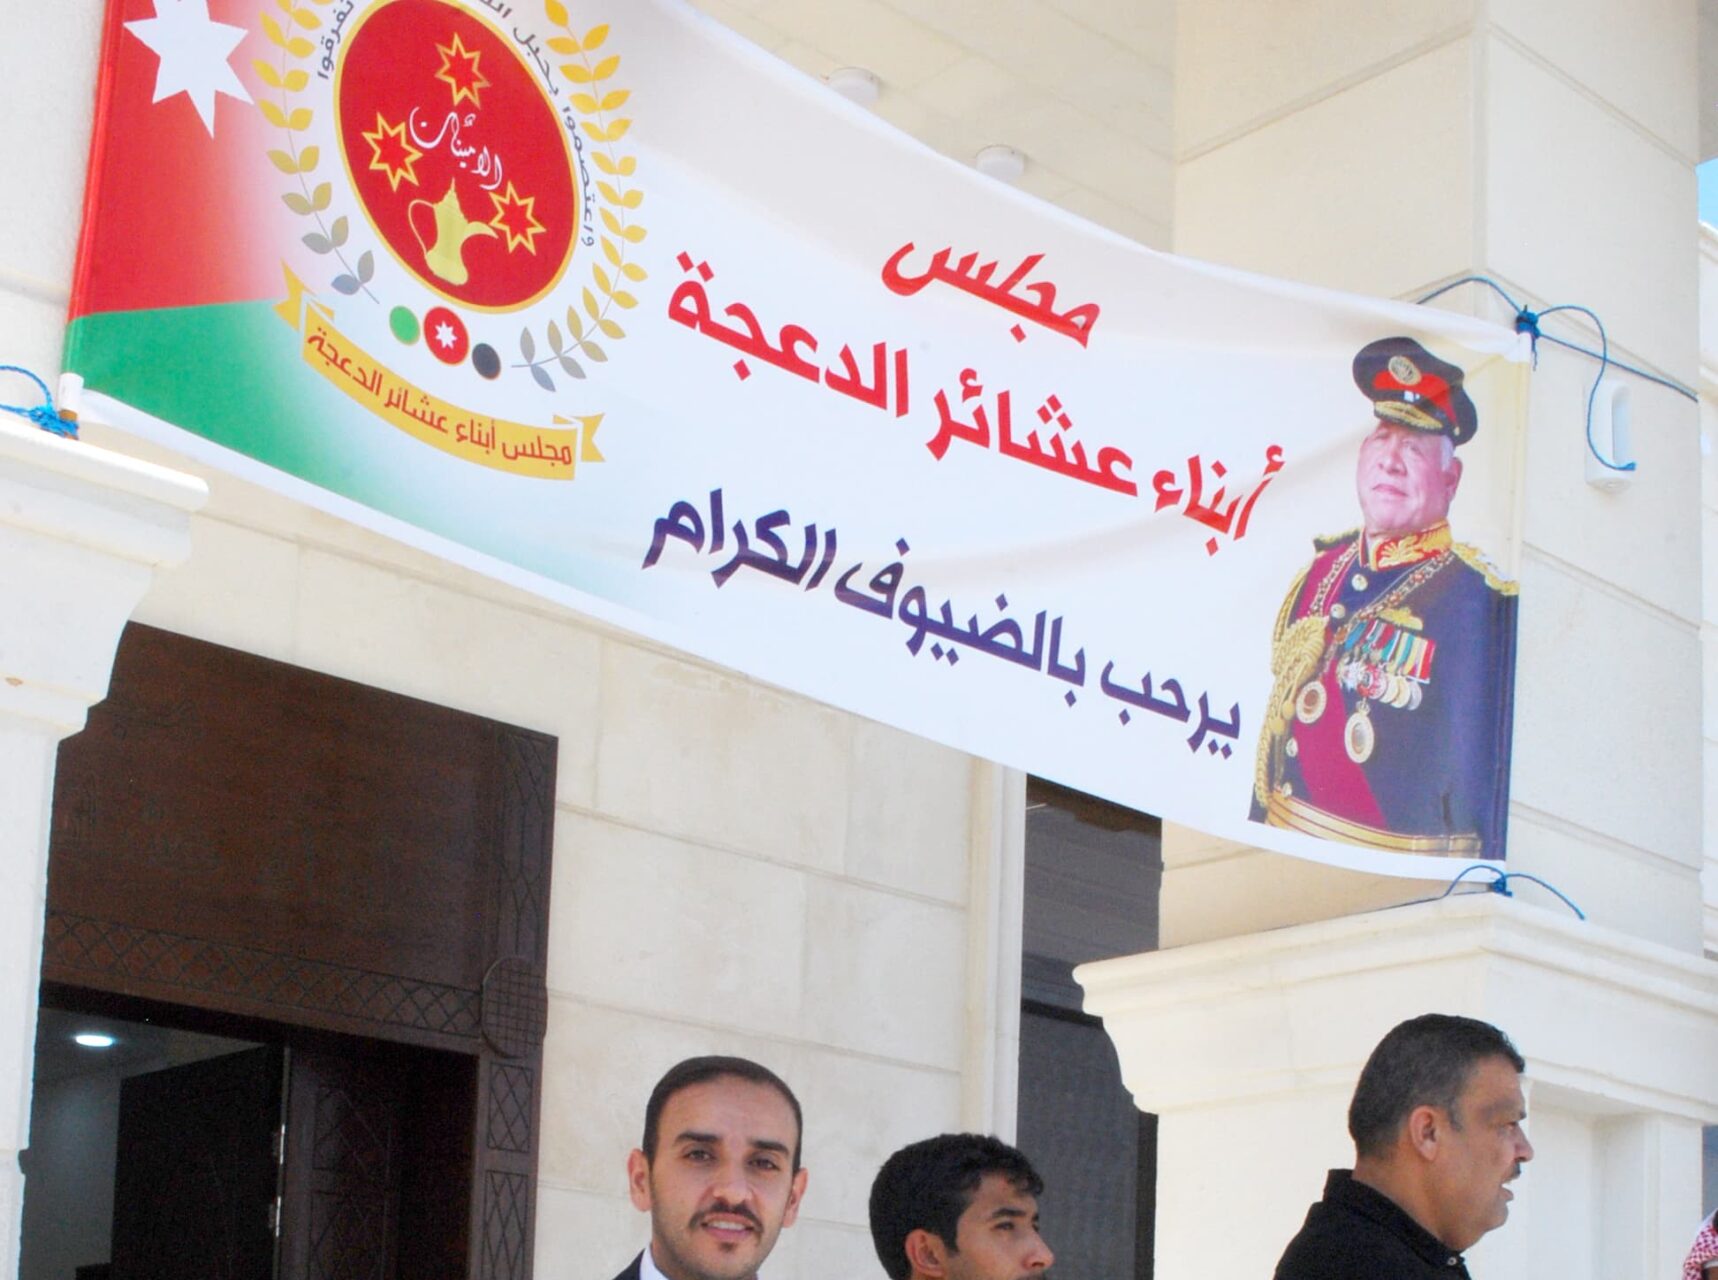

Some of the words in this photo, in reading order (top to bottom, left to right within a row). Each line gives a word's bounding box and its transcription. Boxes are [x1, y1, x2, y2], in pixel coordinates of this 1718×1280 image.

[513, 27, 559, 96] بحبل
[562, 106, 597, 247] واعتصموا
[667, 251, 910, 418] الدعجة
[881, 242, 1101, 348] مجلس
[307, 326, 383, 396] الدعجة
[384, 387, 449, 434] عشائر
[456, 418, 496, 455] أبناء
[502, 435, 572, 467] مجلس
[926, 367, 1138, 497] عشائر
[642, 488, 837, 591] الكرام
[1152, 444, 1285, 556] أبناء
[834, 538, 1086, 707] بالضيوف
[1100, 661, 1240, 760] يرحب
